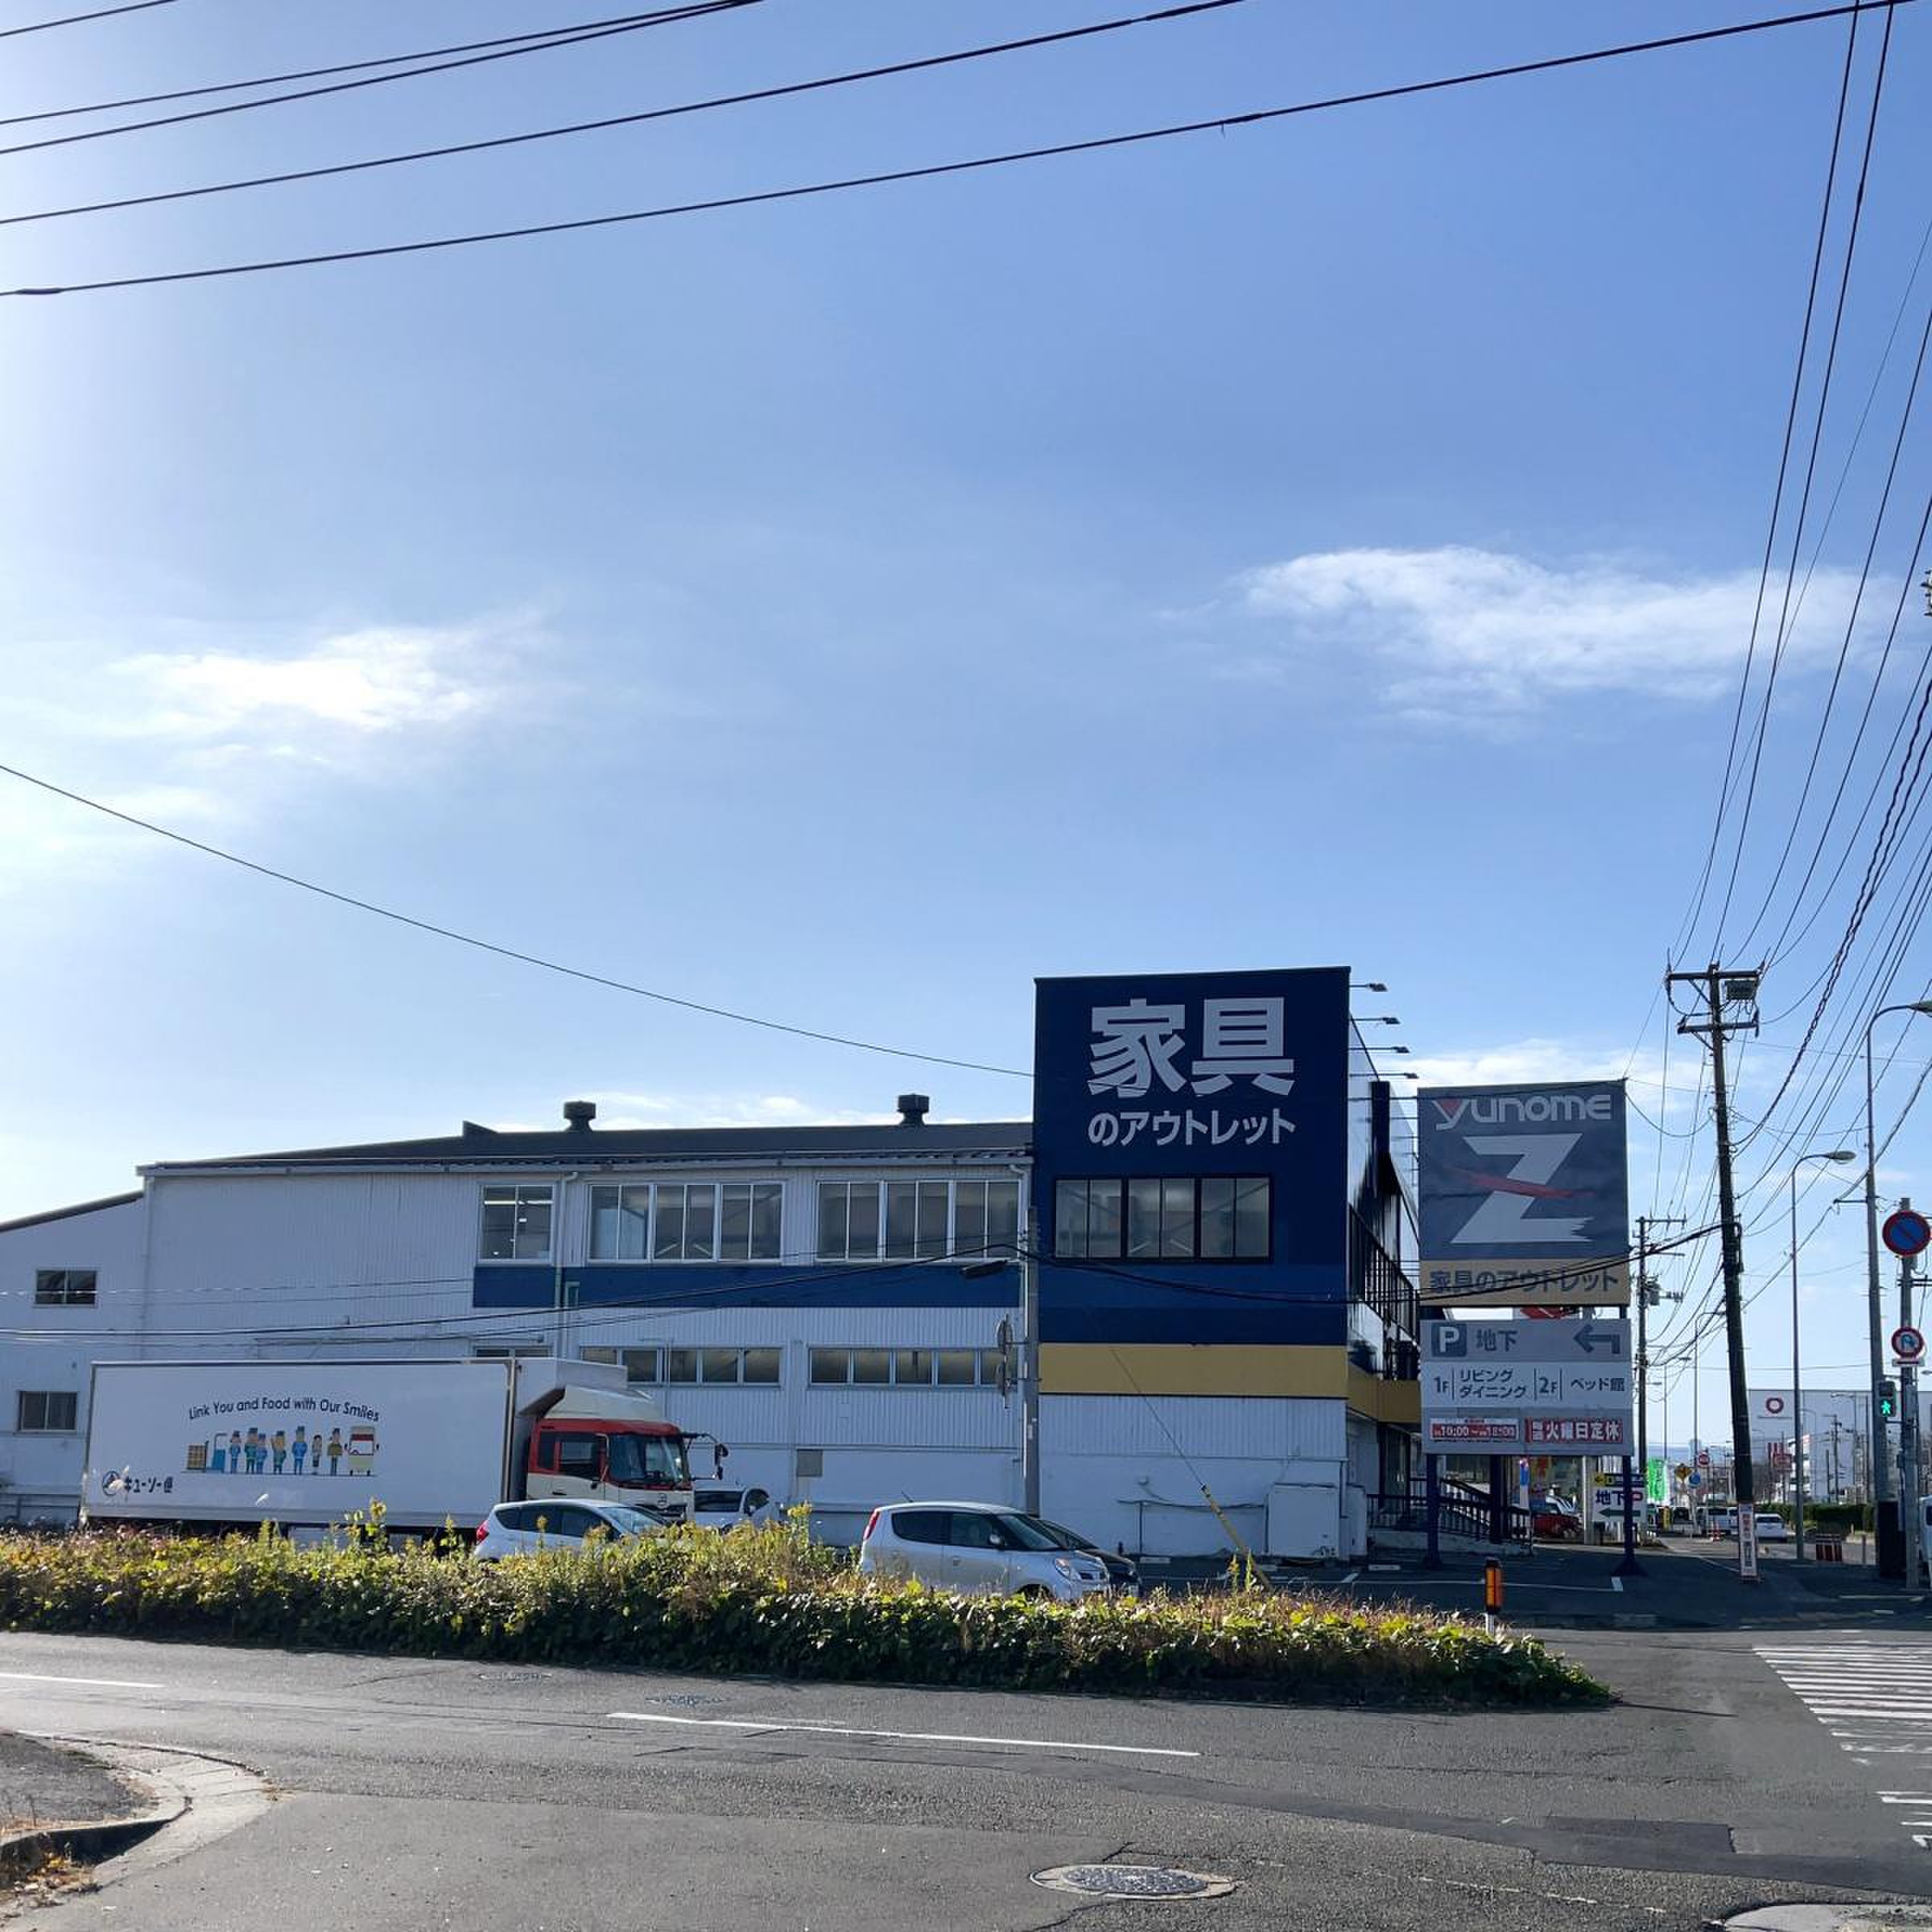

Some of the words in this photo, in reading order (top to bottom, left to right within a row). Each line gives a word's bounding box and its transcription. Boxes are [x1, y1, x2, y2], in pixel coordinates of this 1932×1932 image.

[1087, 997, 1295, 1099] 家具
[1430, 1094, 1612, 1130] yunome
[1087, 1107, 1296, 1146] のアウトレット
[1429, 1269, 1619, 1293] 家具のアウトレット
[1476, 1329, 1518, 1352] 地下
[1434, 1377, 1449, 1393] 1F
[1460, 1368, 1513, 1383] リビング
[1538, 1377, 1558, 1393] 2F
[1460, 1385, 1526, 1399] ダイニング
[189, 1406, 210, 1420] Link
[214, 1402, 233, 1414] You
[237, 1397, 258, 1410] and
[262, 1397, 291, 1410] Food
[295, 1397, 316, 1410] with
[320, 1399, 341, 1414] Our
[343, 1402, 379, 1422] Smiles
